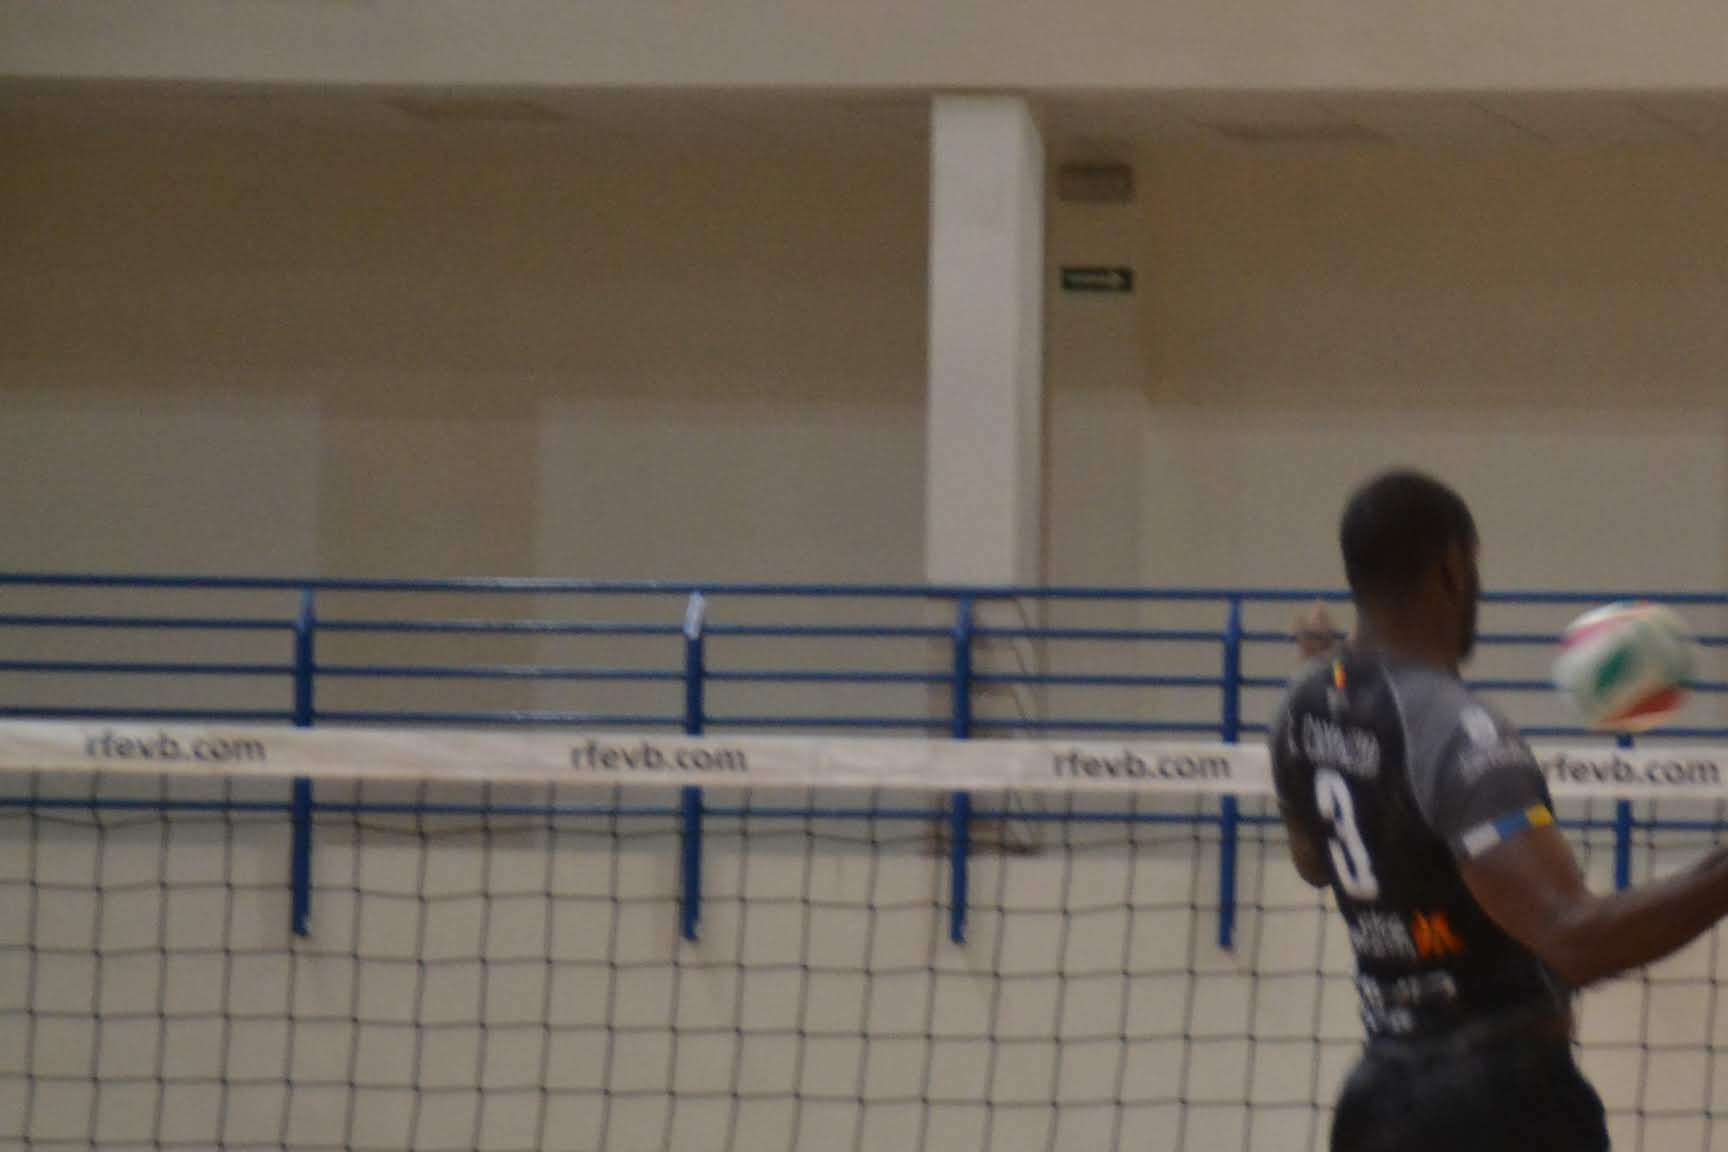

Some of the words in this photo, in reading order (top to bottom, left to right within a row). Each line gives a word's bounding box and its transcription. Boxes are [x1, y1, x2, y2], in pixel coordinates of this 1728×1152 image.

[86, 729, 267, 763] rfevb.com
[570, 739, 748, 773] rfevb.com
[1053, 749, 1231, 781] rfevb.com
